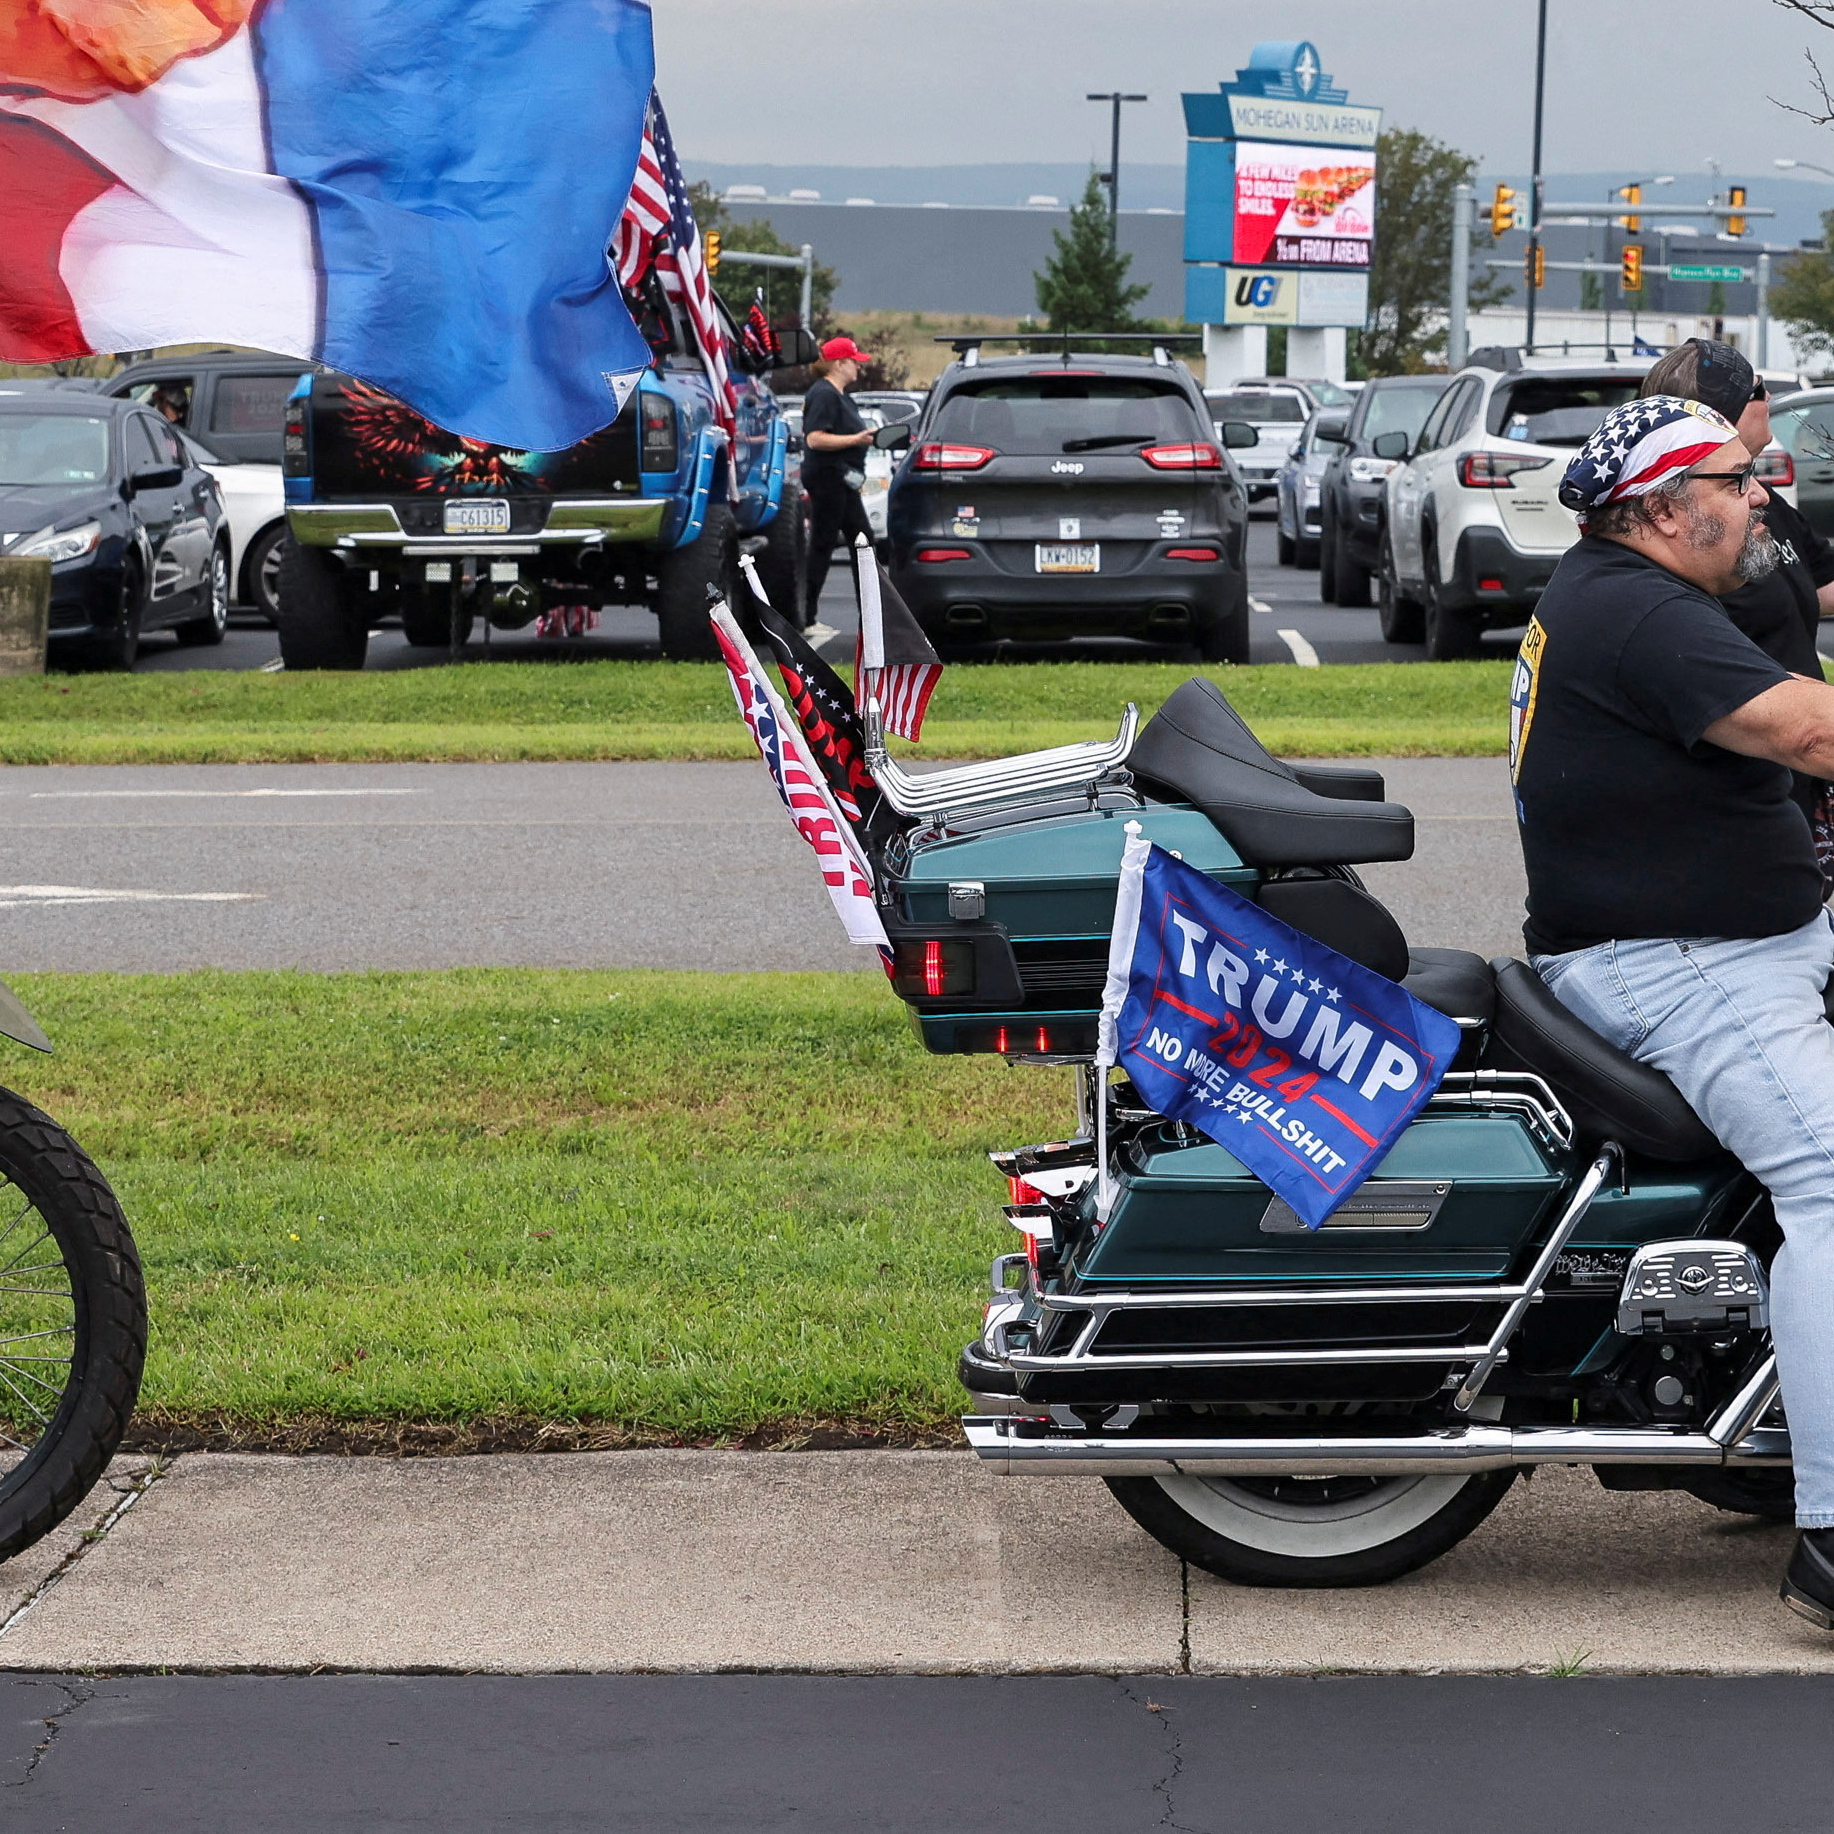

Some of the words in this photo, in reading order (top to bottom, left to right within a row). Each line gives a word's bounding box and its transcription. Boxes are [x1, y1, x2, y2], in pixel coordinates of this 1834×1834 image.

[1235, 107, 1301, 129] MOHEGAN
[1305, 113, 1329, 132] SUN
[1333, 115, 1374, 135] ARENA
[1332, 241, 1369, 264] ARENA
[1051, 460, 1084, 475] Jeep
[1173, 909, 1418, 1101] TRUMP
[1208, 1011, 1321, 1104] 2024
[1146, 1026, 1182, 1062] NO
[1184, 1047, 1231, 1092] MORE
[1226, 1081, 1347, 1175] BULLSHIT
